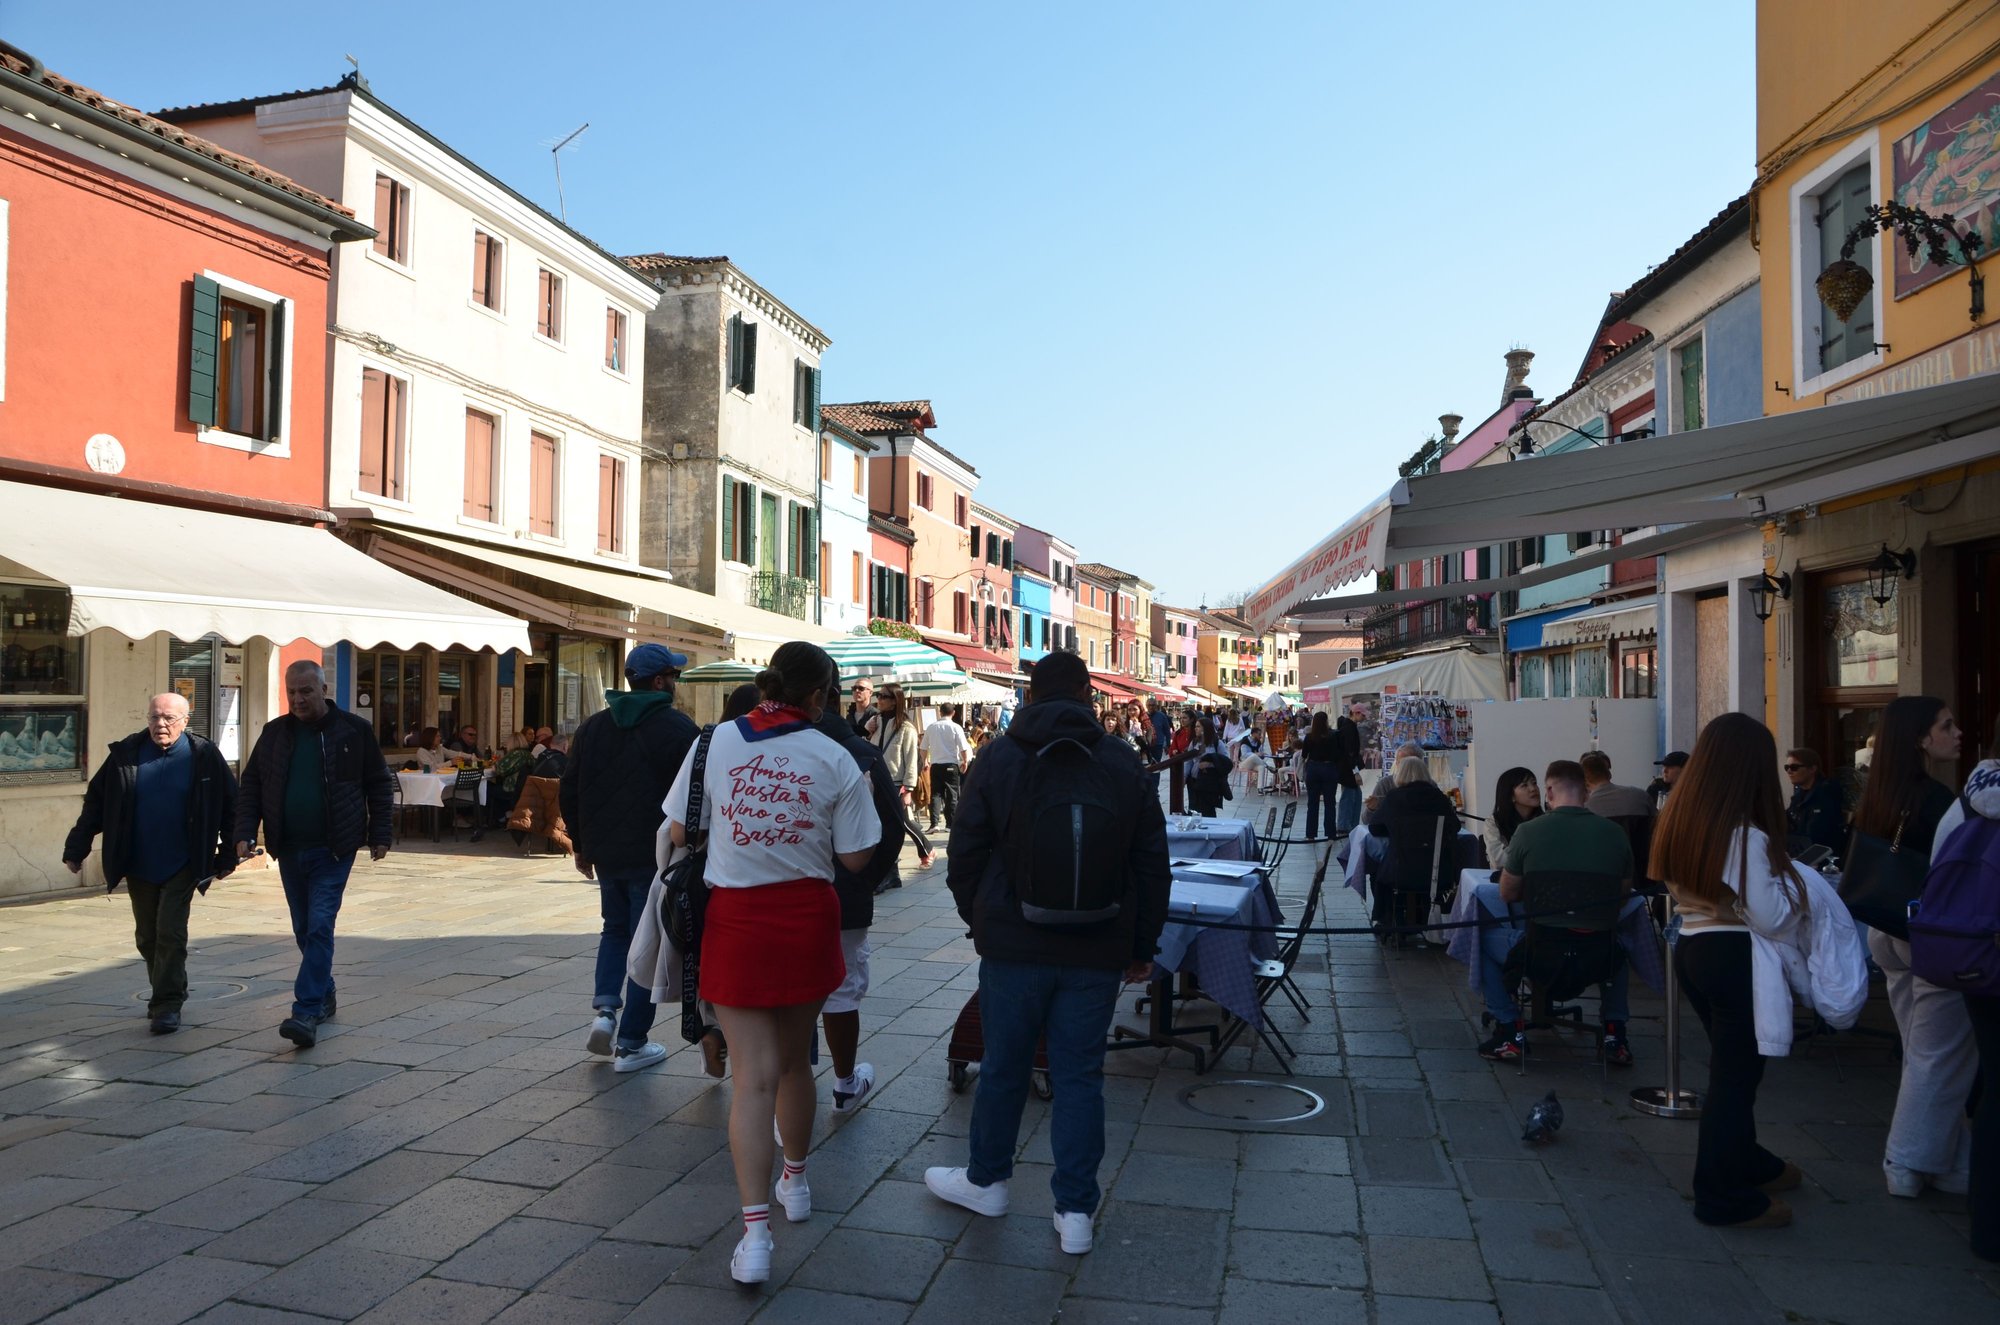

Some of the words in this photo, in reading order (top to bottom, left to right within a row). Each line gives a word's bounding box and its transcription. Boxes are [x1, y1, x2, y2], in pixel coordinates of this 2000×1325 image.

[1310, 546, 1338, 578] RASPO
[1339, 535, 1354, 562] DE
[728, 754, 815, 786] Amore
[731, 778, 796, 803] Pasta
[686, 782, 702, 833] GUESS
[775, 812, 791, 824] e
[731, 820, 804, 847] Basta
[683, 952, 696, 1004] GUESS
